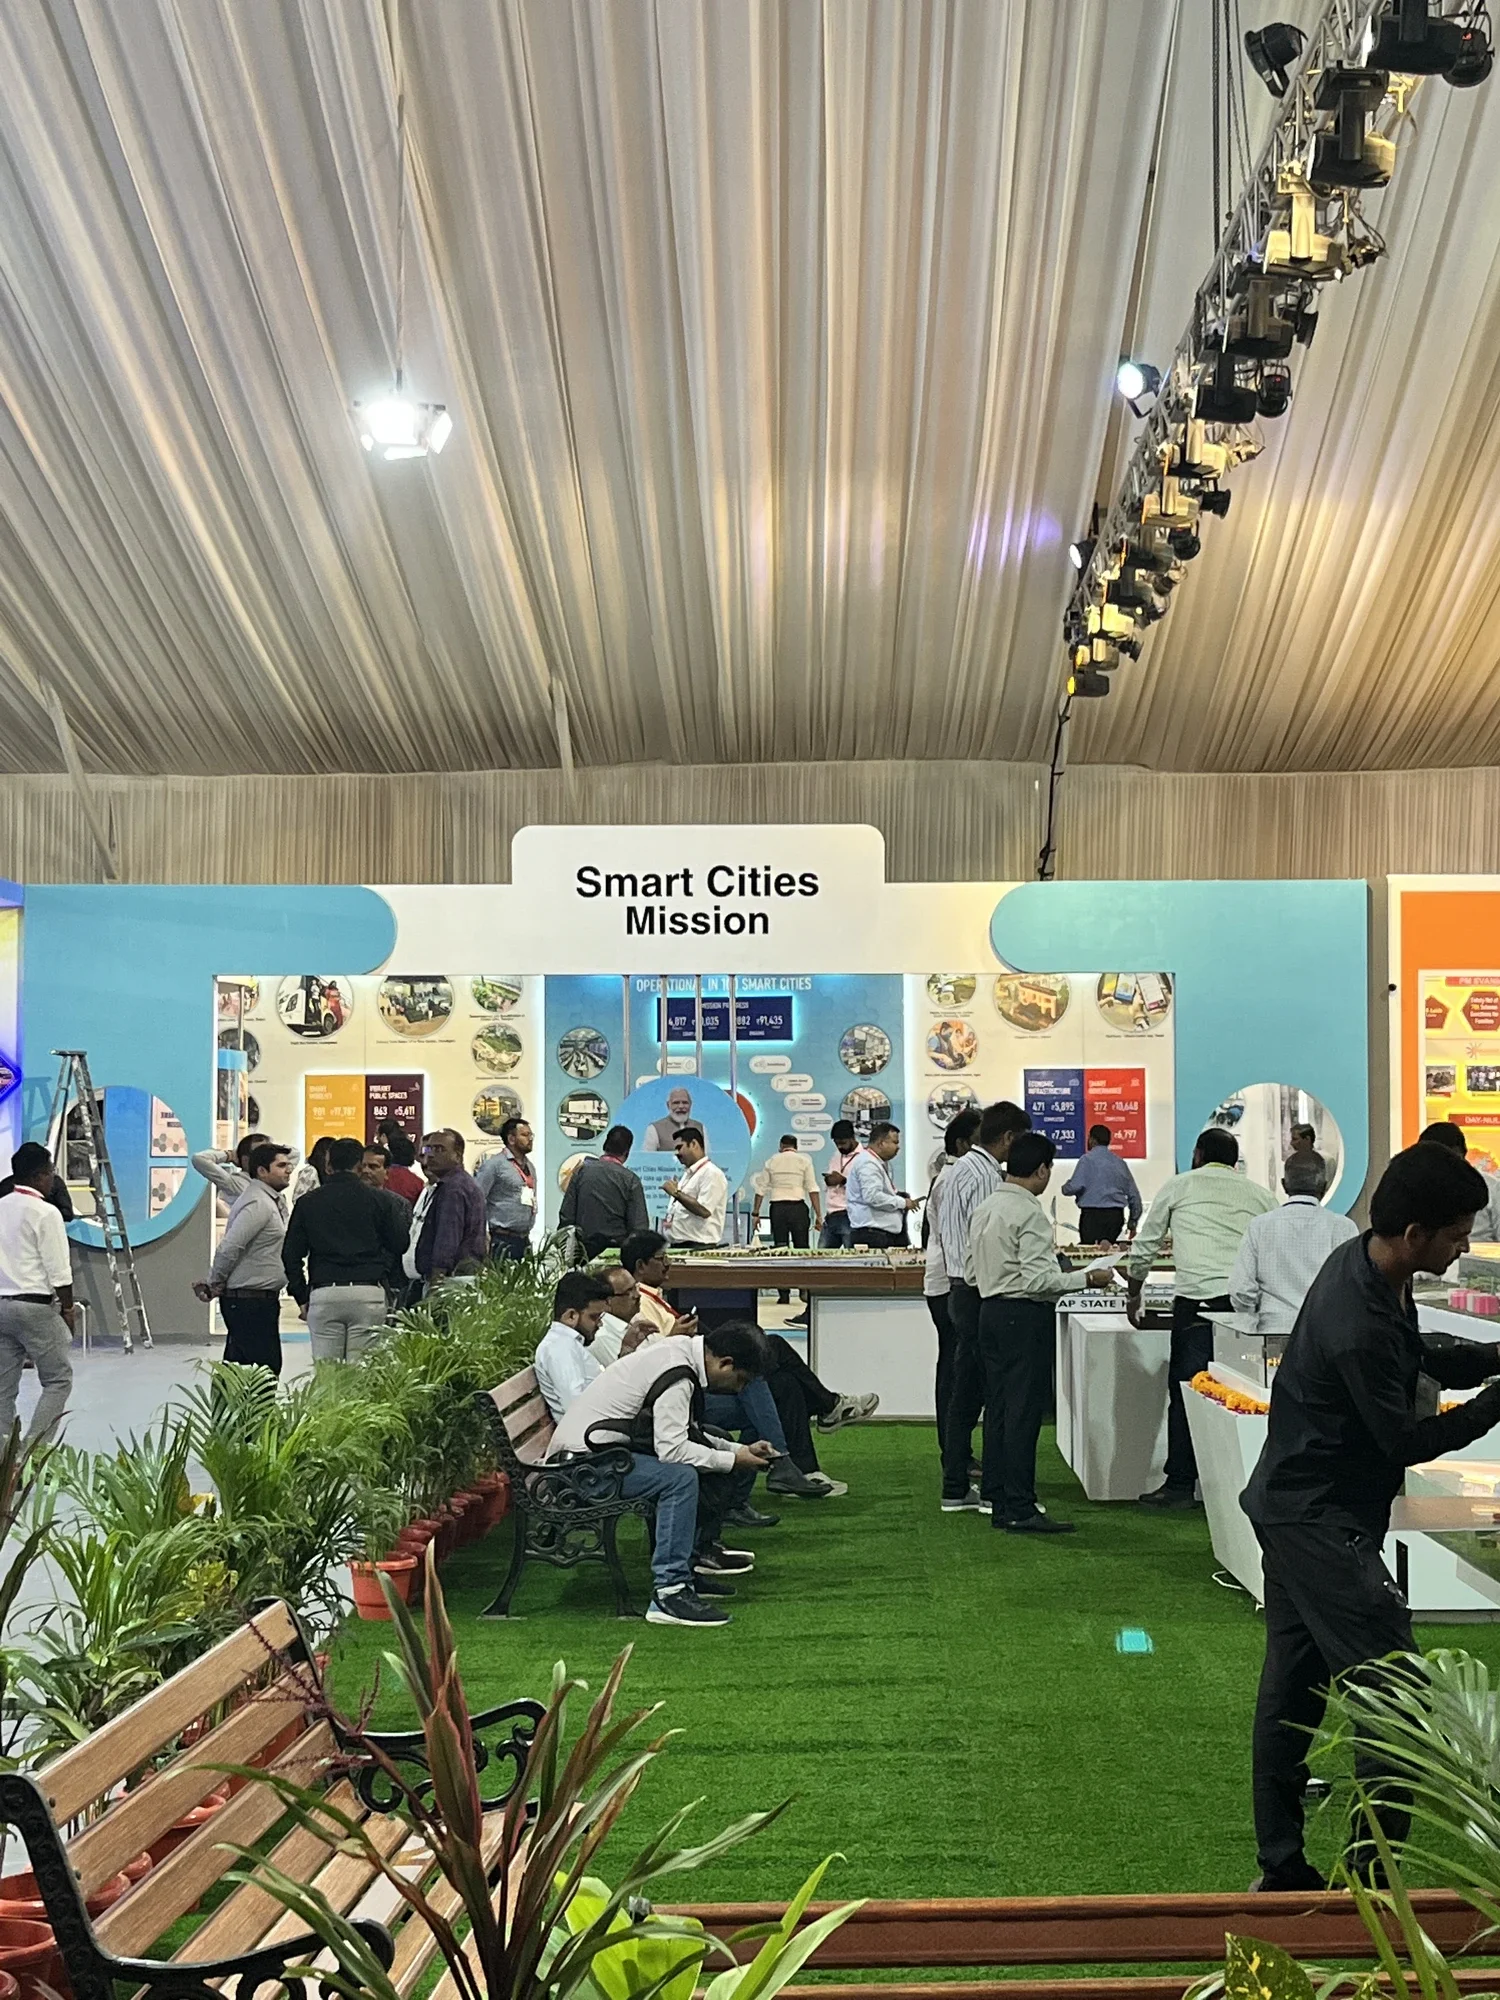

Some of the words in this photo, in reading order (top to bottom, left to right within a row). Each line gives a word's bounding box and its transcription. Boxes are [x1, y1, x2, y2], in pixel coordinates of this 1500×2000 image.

[576, 866, 693, 897] Smart
[707, 865, 819, 897] Cities
[626, 905, 769, 935] Mission
[636, 978, 704, 992] OPERATIONA
[708, 979, 718, 991] IN
[742, 977, 777, 991] SMART
[780, 977, 812, 990] CITIES
[1032, 1102, 1045, 1111] 471
[1094, 1102, 1107, 1111] 372
[1058, 1300, 1076, 1308] AP
[1080, 1300, 1116, 1308] STATE
